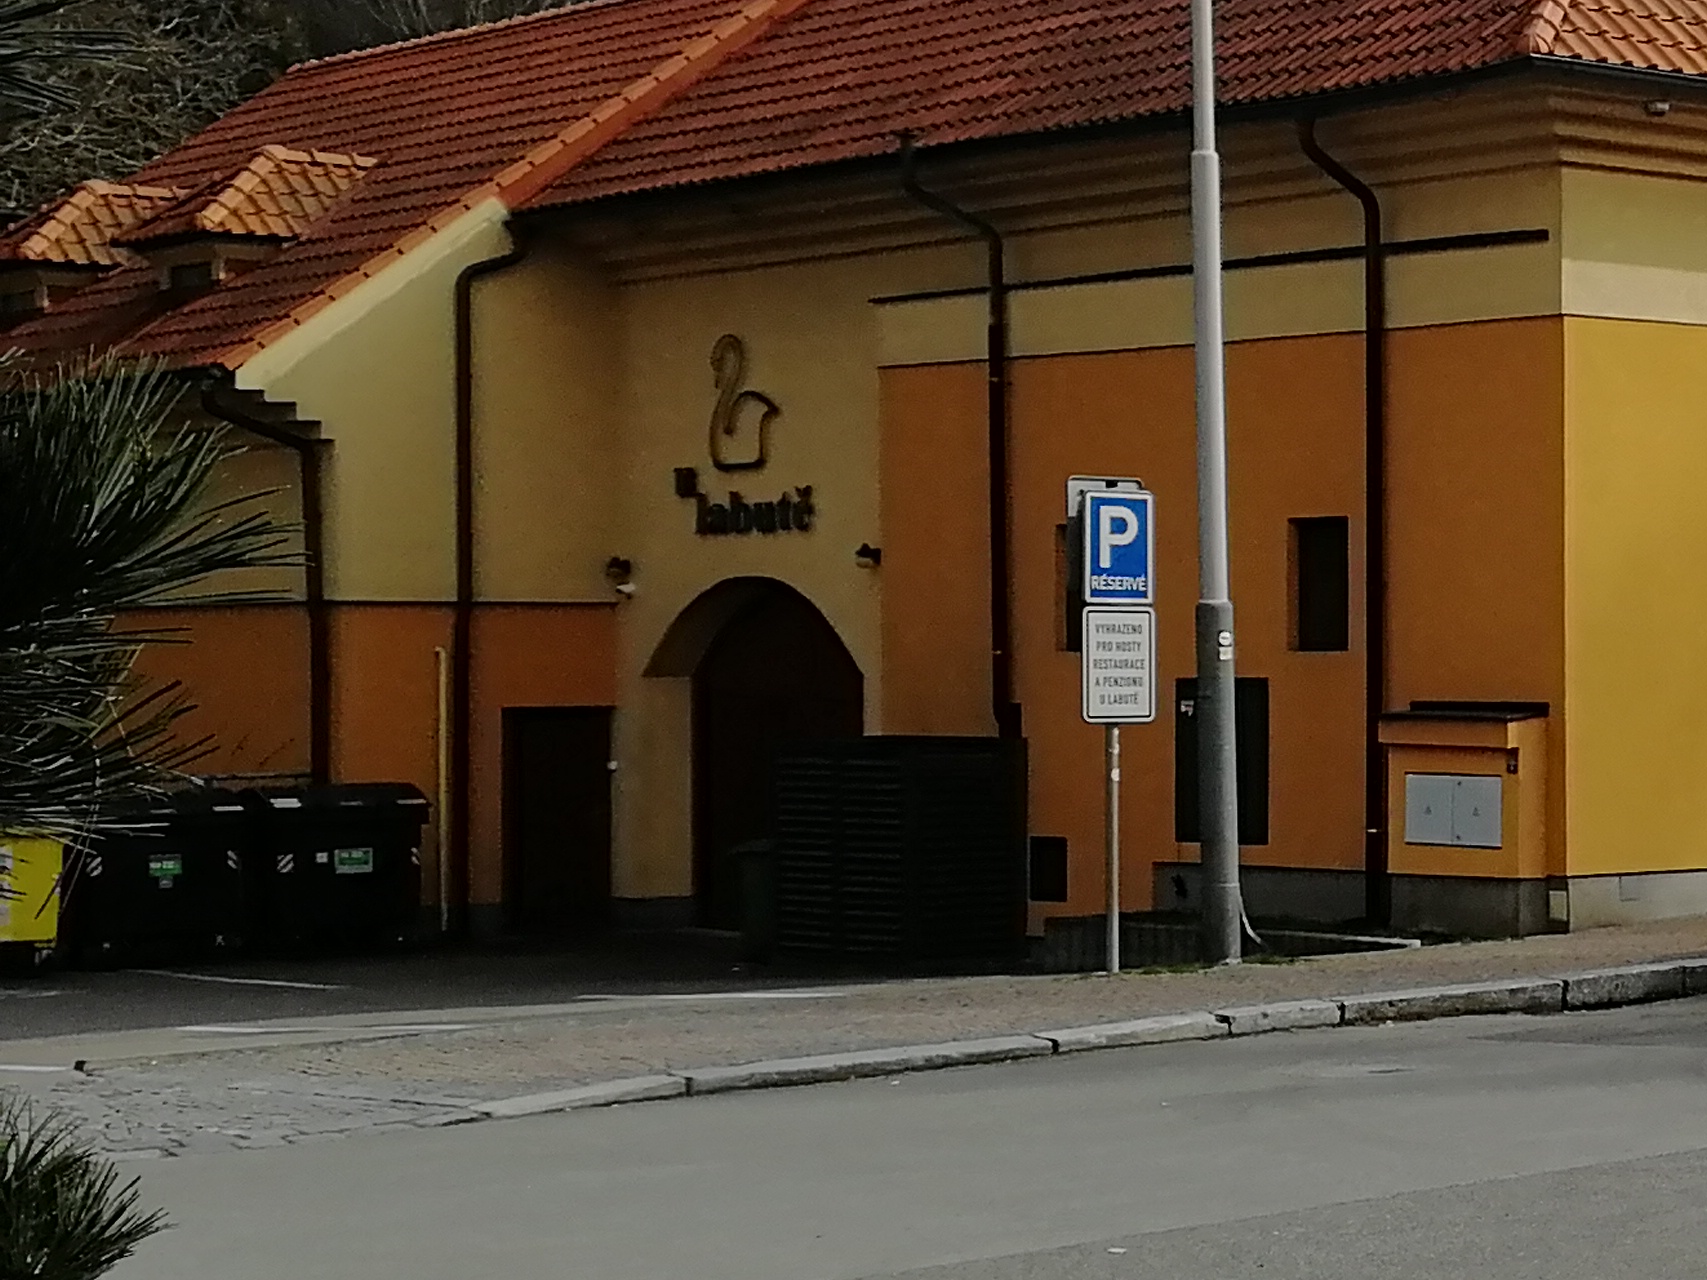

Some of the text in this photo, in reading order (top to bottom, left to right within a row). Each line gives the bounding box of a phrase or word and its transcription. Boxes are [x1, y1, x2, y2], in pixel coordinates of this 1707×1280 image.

[695, 485, 816, 535] labutě
[1099, 505, 1139, 569] P
[1091, 573, 1147, 591] RÉSERVÉ
[1094, 623, 1143, 635] VYHRAZENO
[1096, 640, 1142, 652] PRO HOSTY
[1092, 658, 1146, 670] RESTAURACE
[1094, 676, 1143, 688] A PENZIONU
[1100, 694, 1106, 705] U
